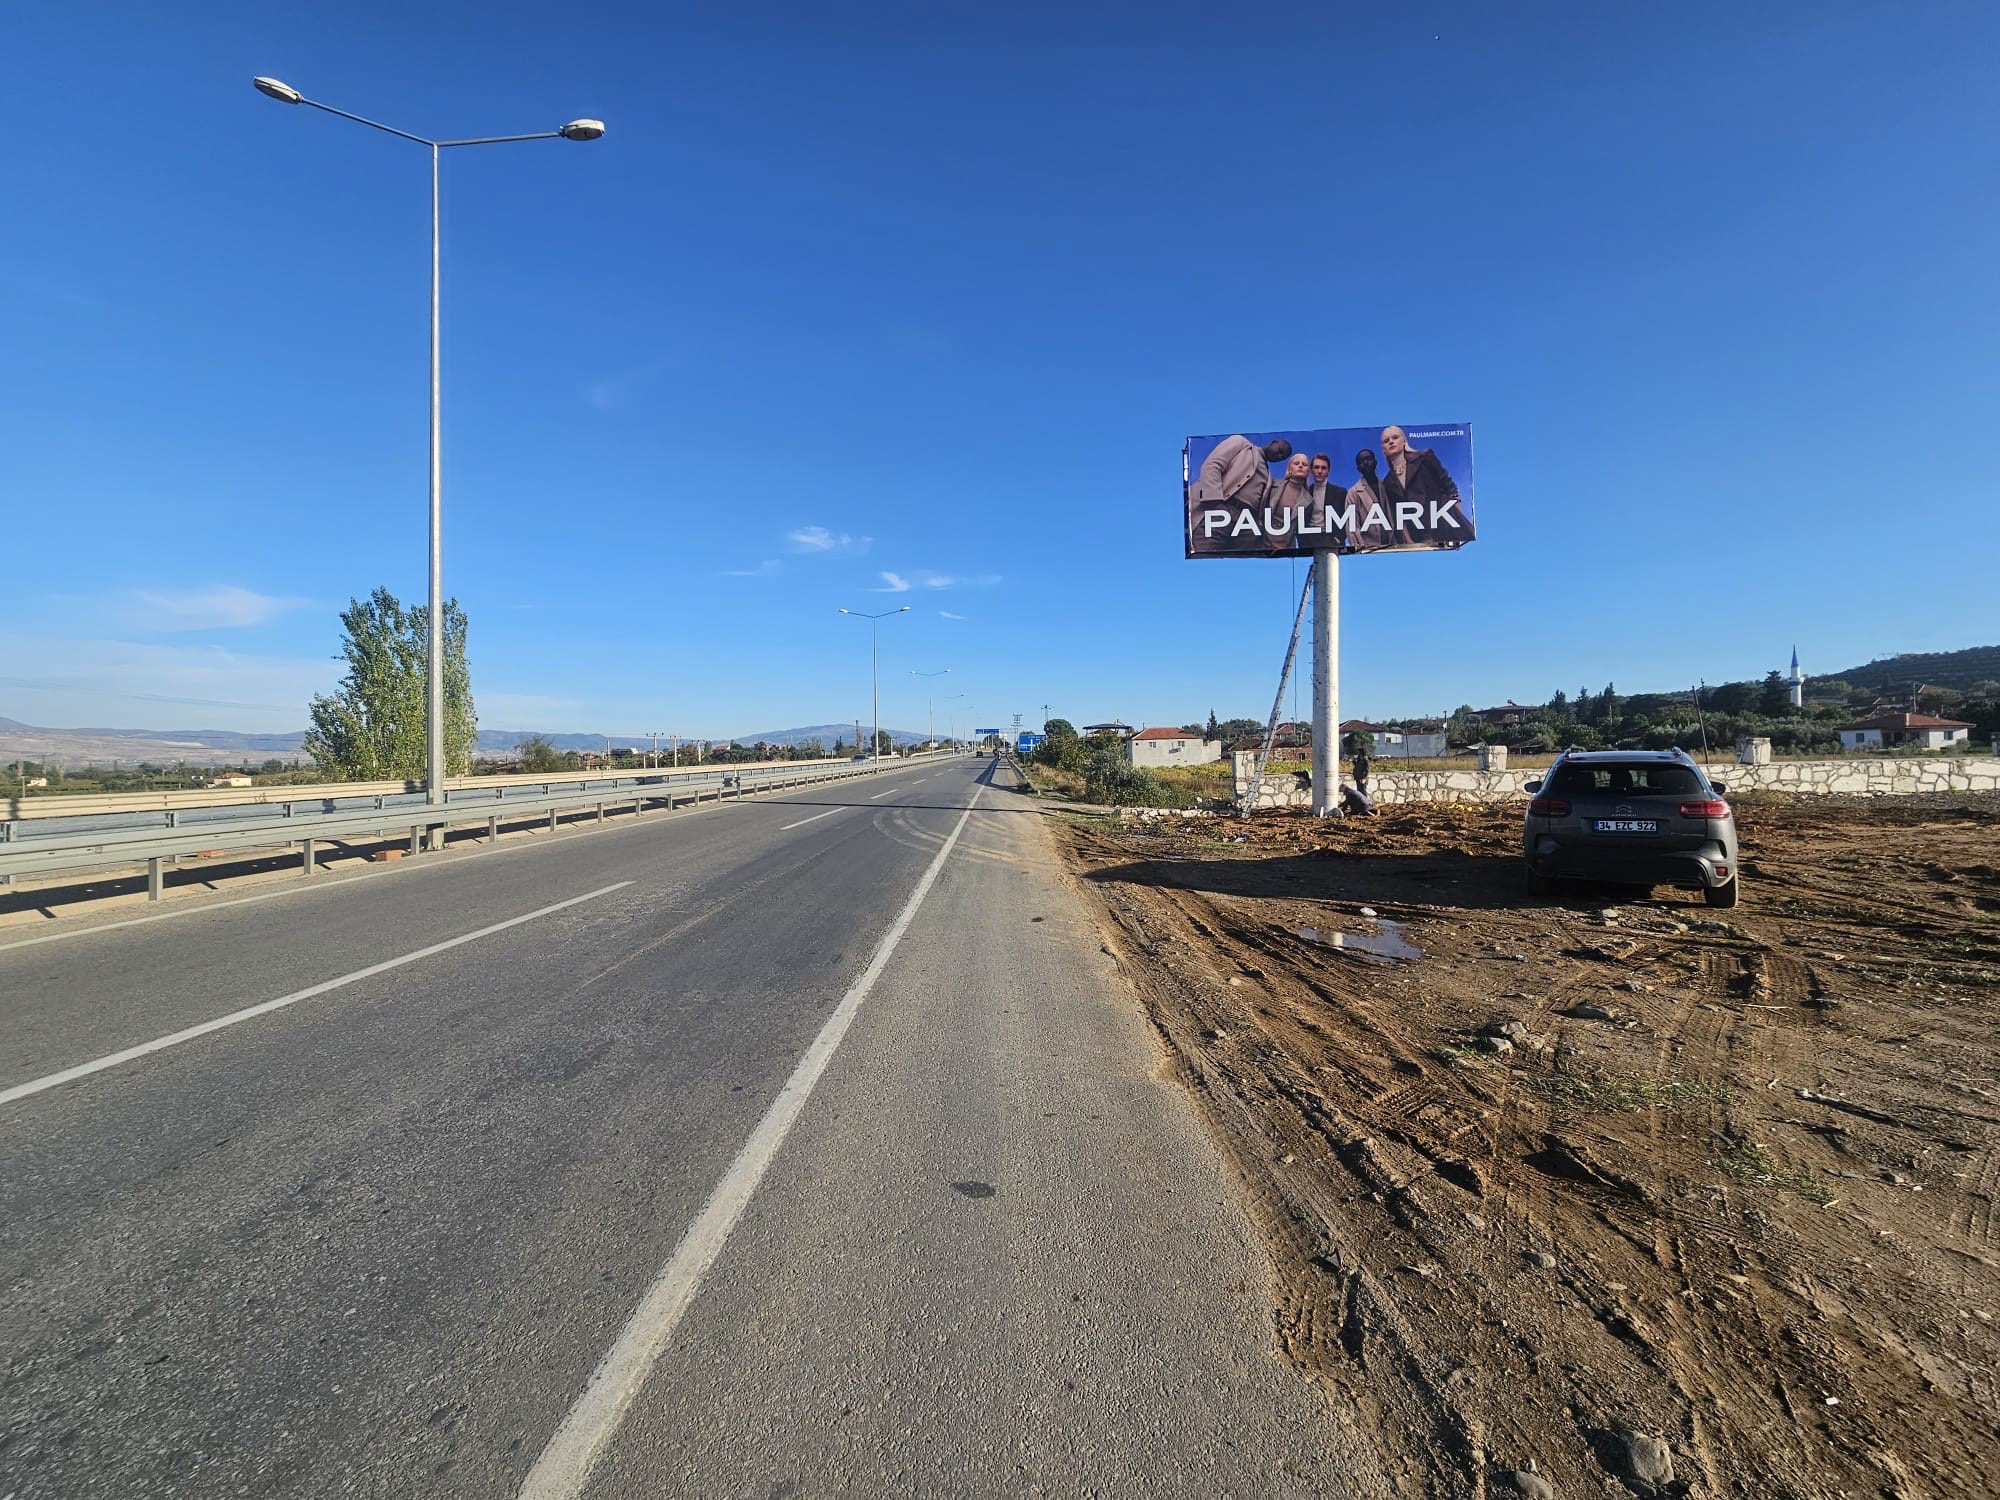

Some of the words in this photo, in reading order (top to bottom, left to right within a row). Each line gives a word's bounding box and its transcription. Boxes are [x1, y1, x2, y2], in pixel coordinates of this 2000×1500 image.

[1409, 430, 1464, 438] PAULMARK.COM.TR
[1204, 500, 1461, 538] PAULMARK
[1600, 822, 1611, 830] 34
[1616, 822, 1633, 830] EZC
[1637, 822, 1655, 831] 922
